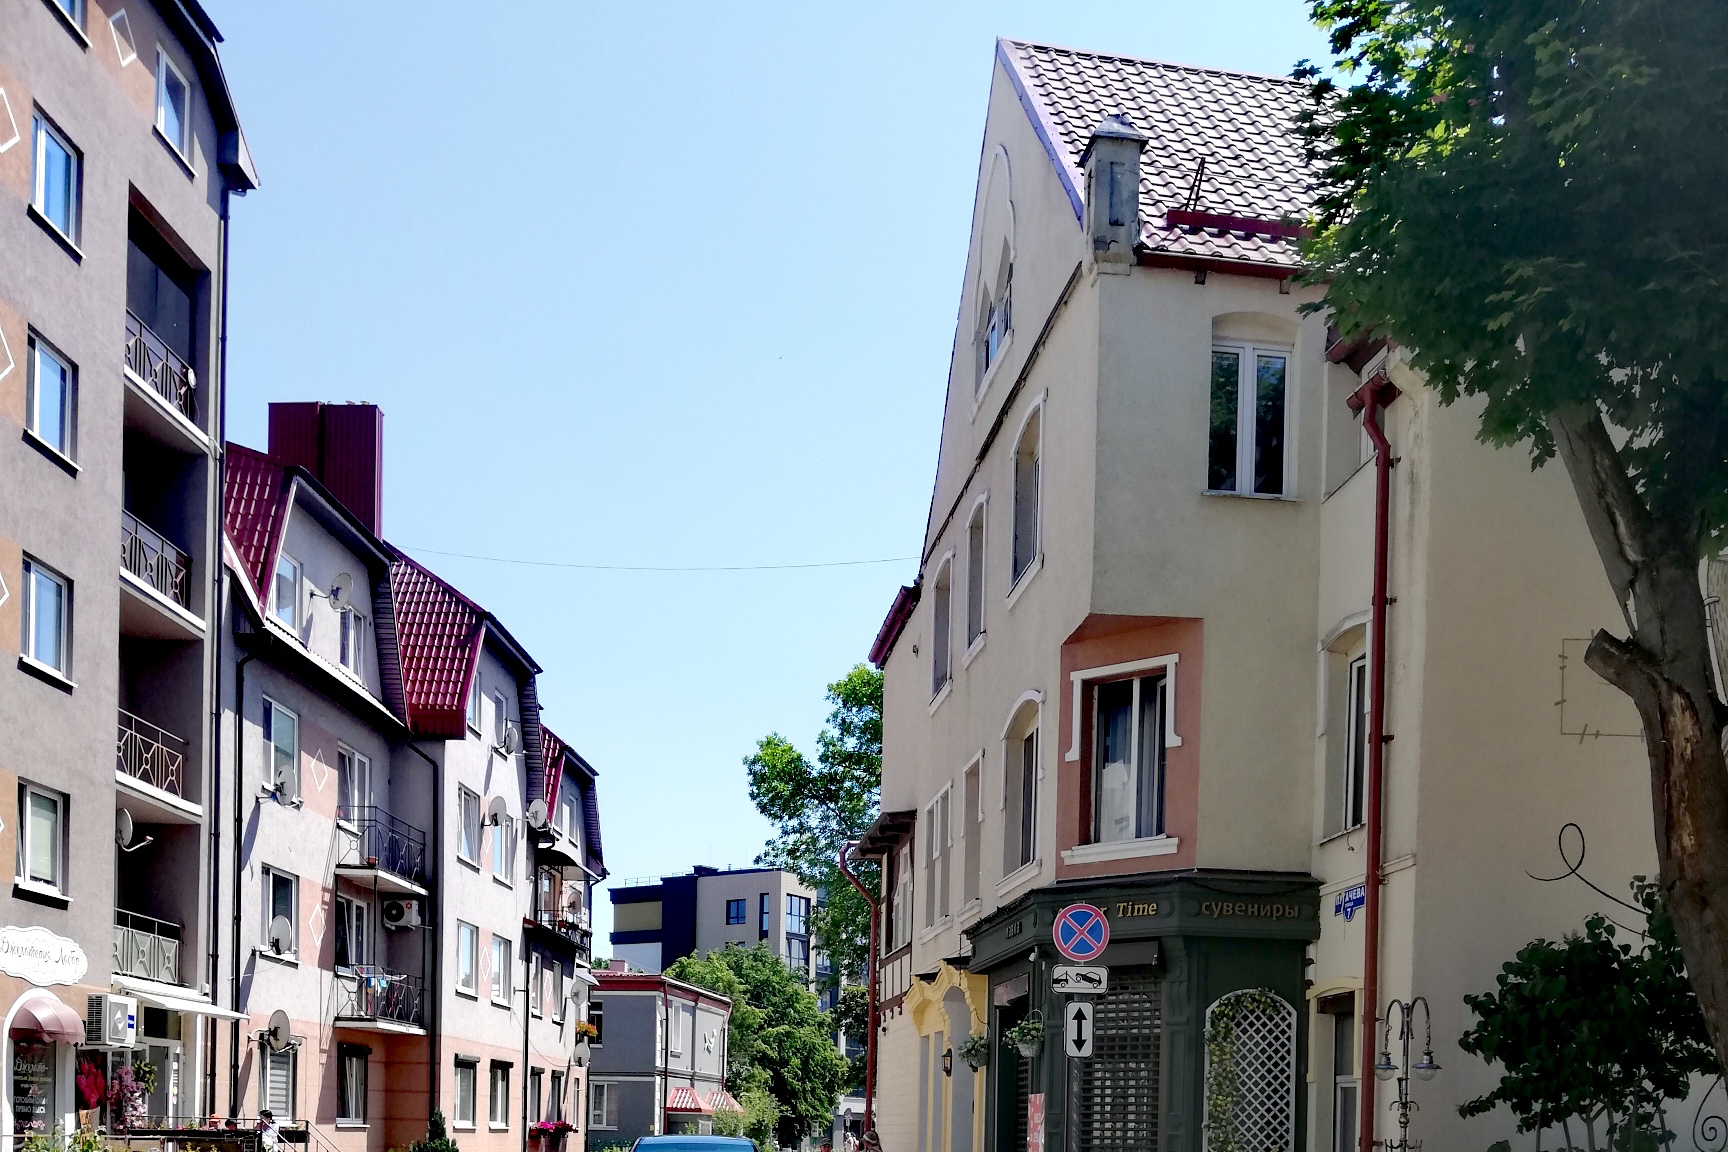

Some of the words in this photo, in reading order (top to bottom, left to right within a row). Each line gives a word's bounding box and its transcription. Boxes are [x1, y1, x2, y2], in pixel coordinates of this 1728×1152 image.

[1117, 902, 1157, 917] Time
[1201, 901, 1299, 920] сувениры
[1347, 908, 1352, 919] 7
